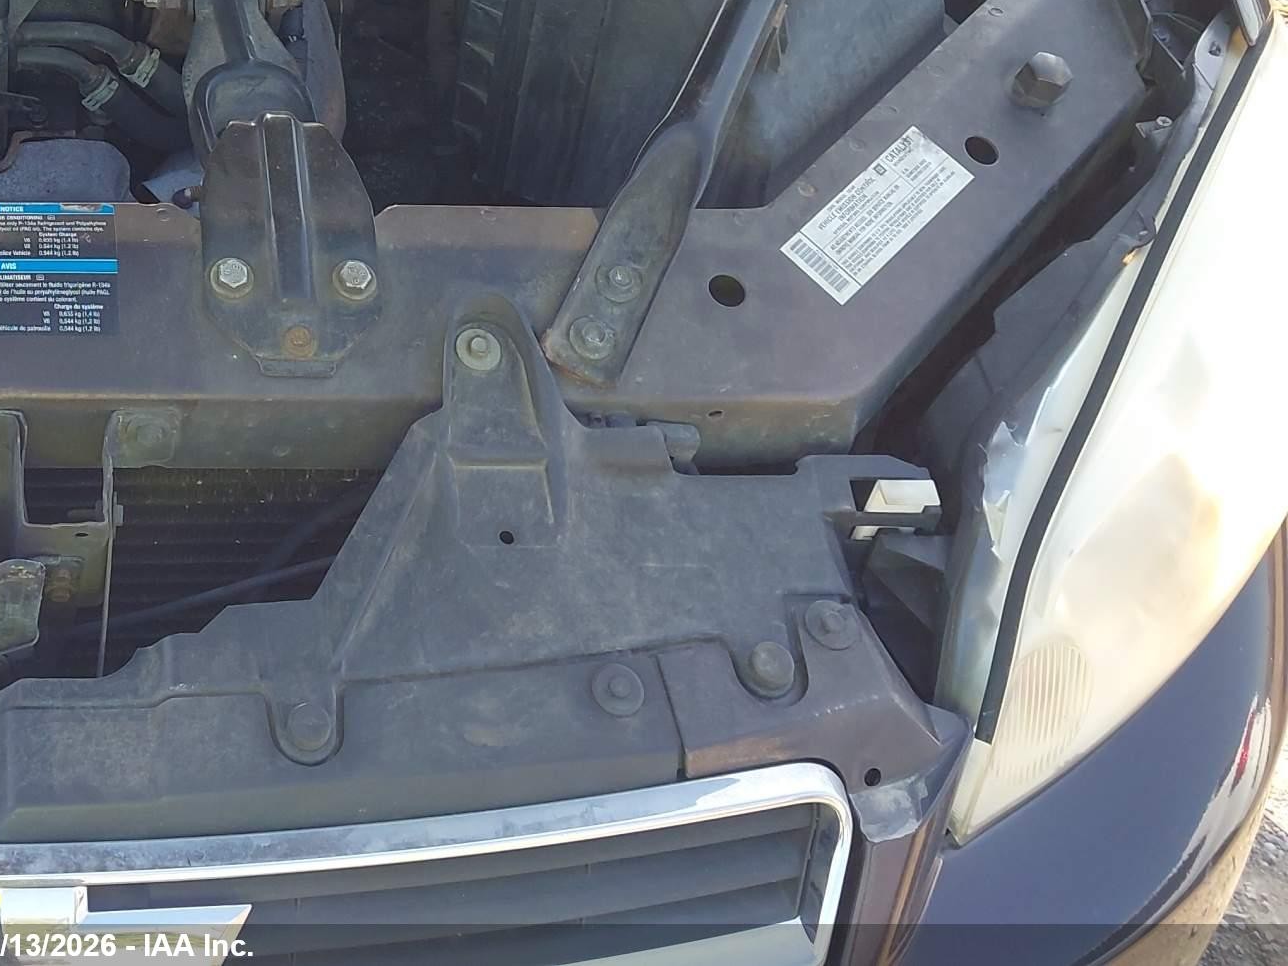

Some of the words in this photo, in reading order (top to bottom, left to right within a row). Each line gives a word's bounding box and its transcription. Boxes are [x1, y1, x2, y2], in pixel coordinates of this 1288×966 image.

[885, 136, 914, 162] CATALYST
[817, 212, 837, 230] VEHICLE
[834, 194, 857, 214] EMISSION
[854, 176, 876, 196] CONTROL
[838, 194, 868, 221] INFORMATION
